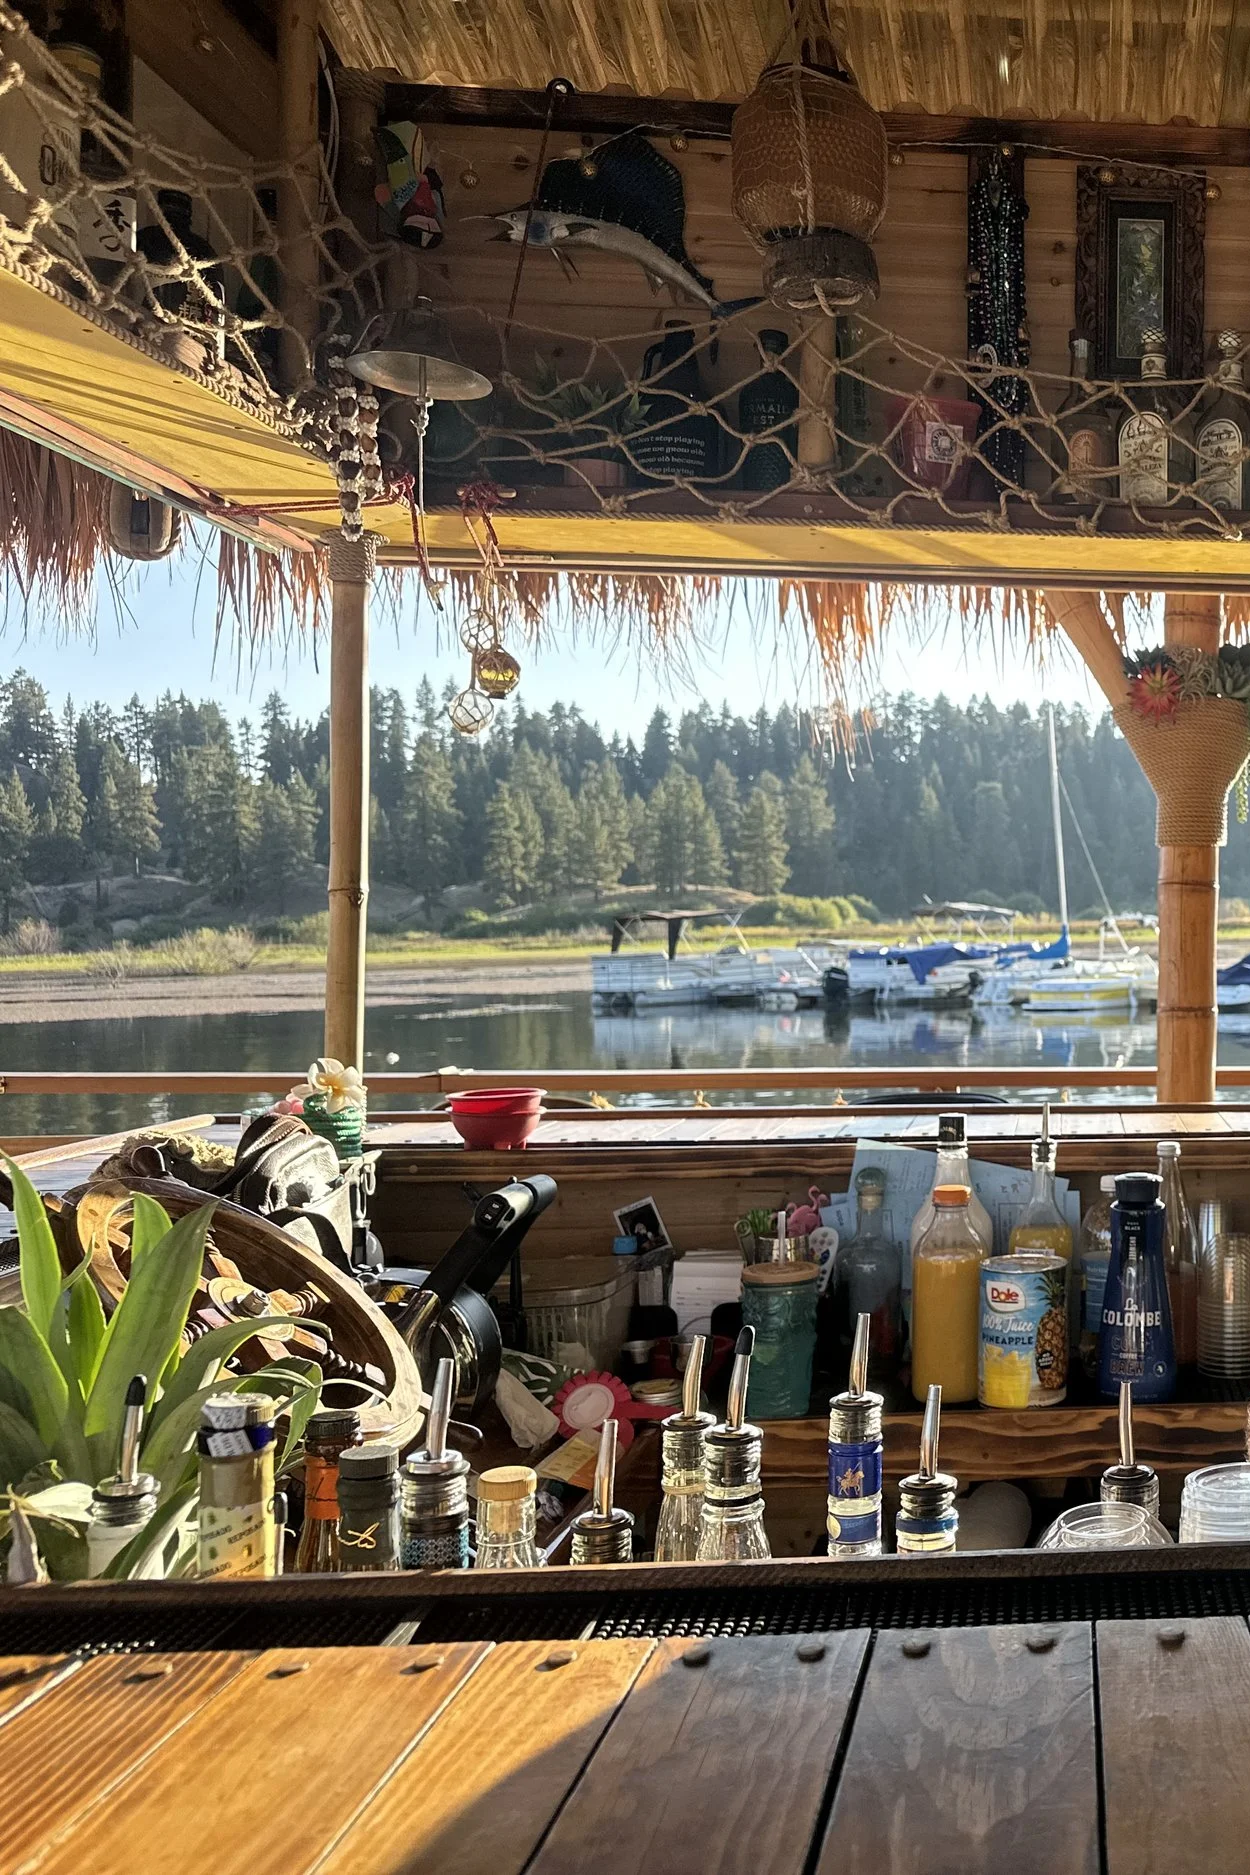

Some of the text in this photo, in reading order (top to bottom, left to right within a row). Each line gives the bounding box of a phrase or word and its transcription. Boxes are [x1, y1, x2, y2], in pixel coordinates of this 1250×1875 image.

[674, 436, 706, 448] playing
[991, 1287, 1019, 1302] Dole
[983, 1313, 1035, 1334] 100% Juice
[1102, 1309, 1161, 1328] COLOMBE
[981, 1332, 1034, 1346] PINEAPPLE
